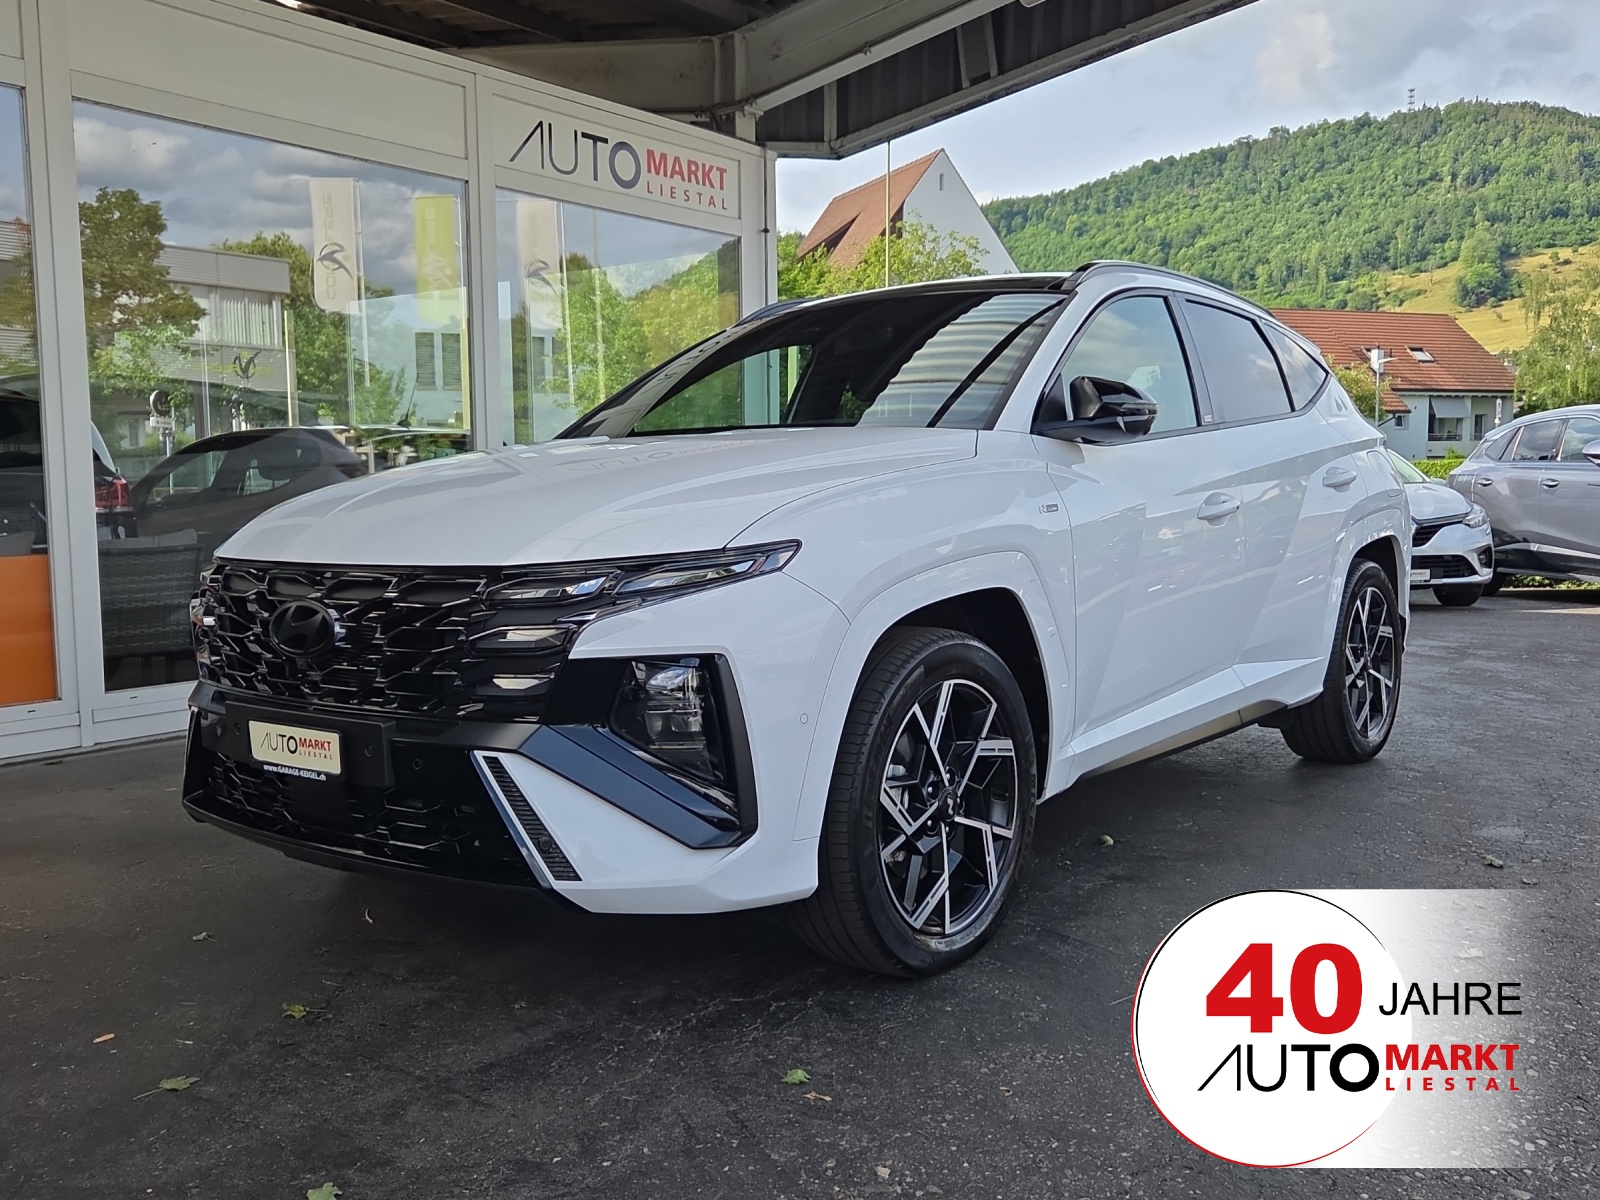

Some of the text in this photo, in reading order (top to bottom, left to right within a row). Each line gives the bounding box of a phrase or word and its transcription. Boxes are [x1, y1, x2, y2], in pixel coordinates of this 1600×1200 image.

[509, 120, 728, 191] AUTO MARKT
[646, 180, 728, 211] LIESTAL
[260, 731, 332, 755] AUTO MARKT
[298, 750, 333, 761] LIESTAL
